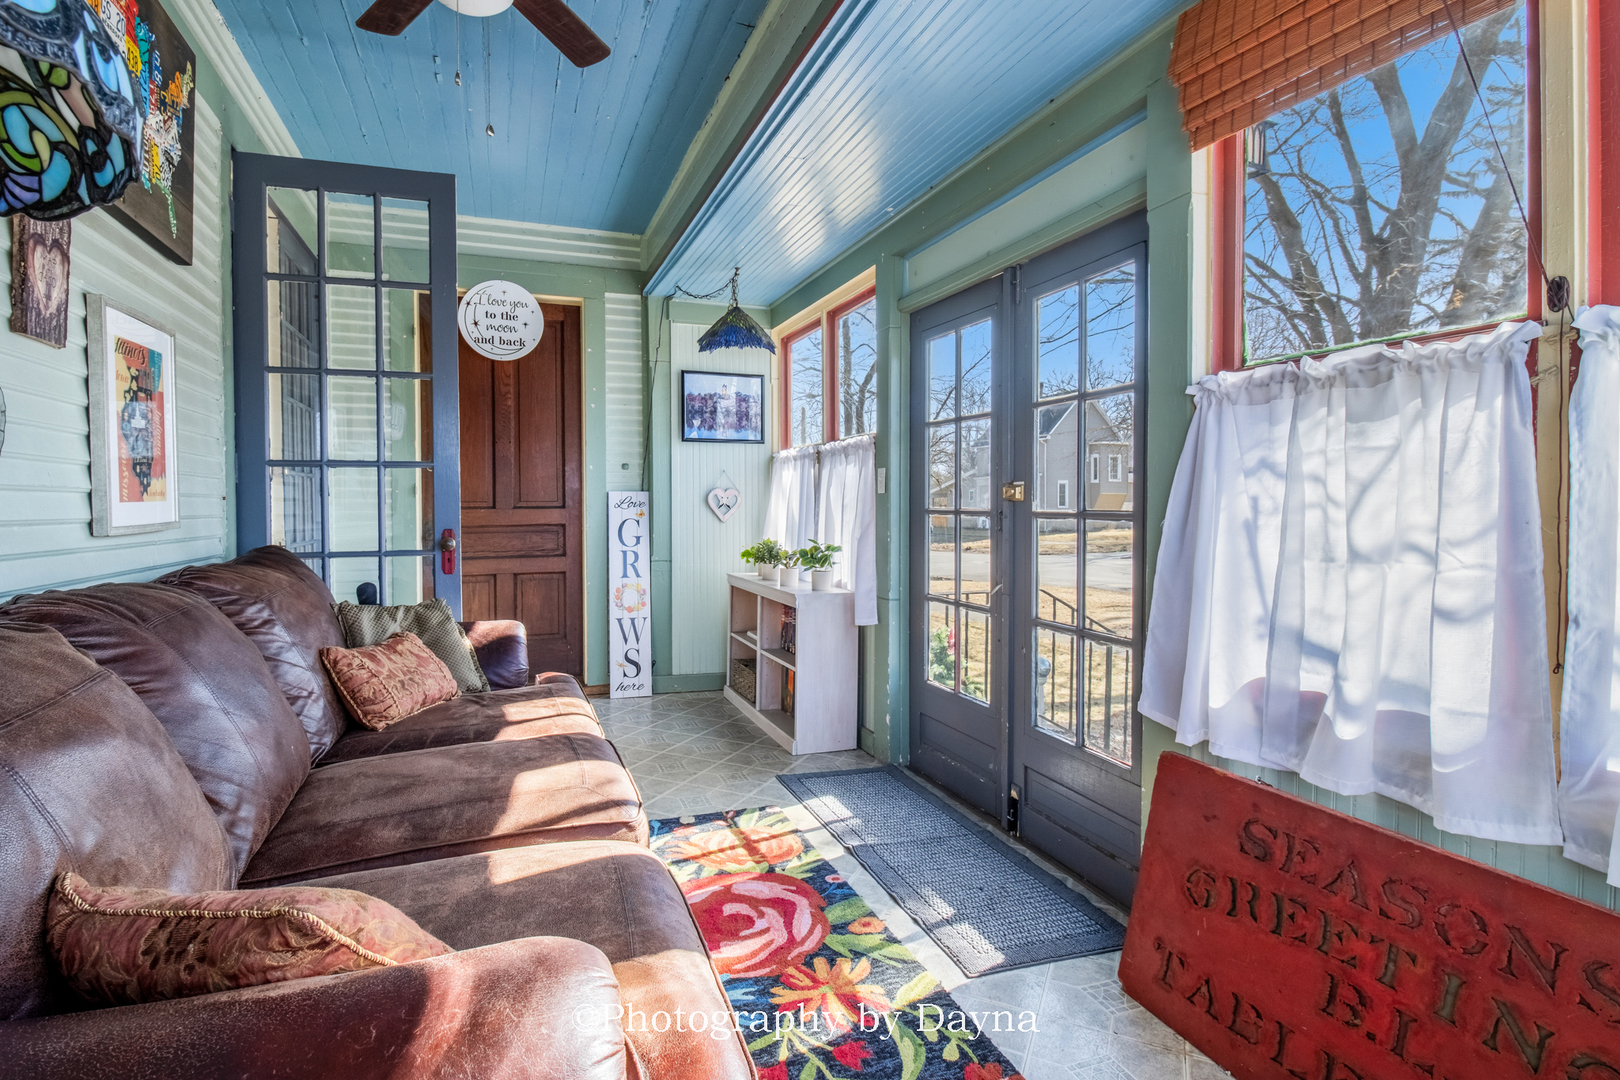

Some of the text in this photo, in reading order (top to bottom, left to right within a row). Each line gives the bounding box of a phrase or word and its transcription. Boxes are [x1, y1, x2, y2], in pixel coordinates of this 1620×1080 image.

[487, 293, 508, 307] love
[509, 300, 529, 314] you
[485, 310, 519, 322] to the
[486, 323, 519, 333] moon
[473, 335, 526, 347] and back
[114, 337, 146, 366] Illinois
[614, 495, 647, 510] Love
[615, 679, 646, 693] here
